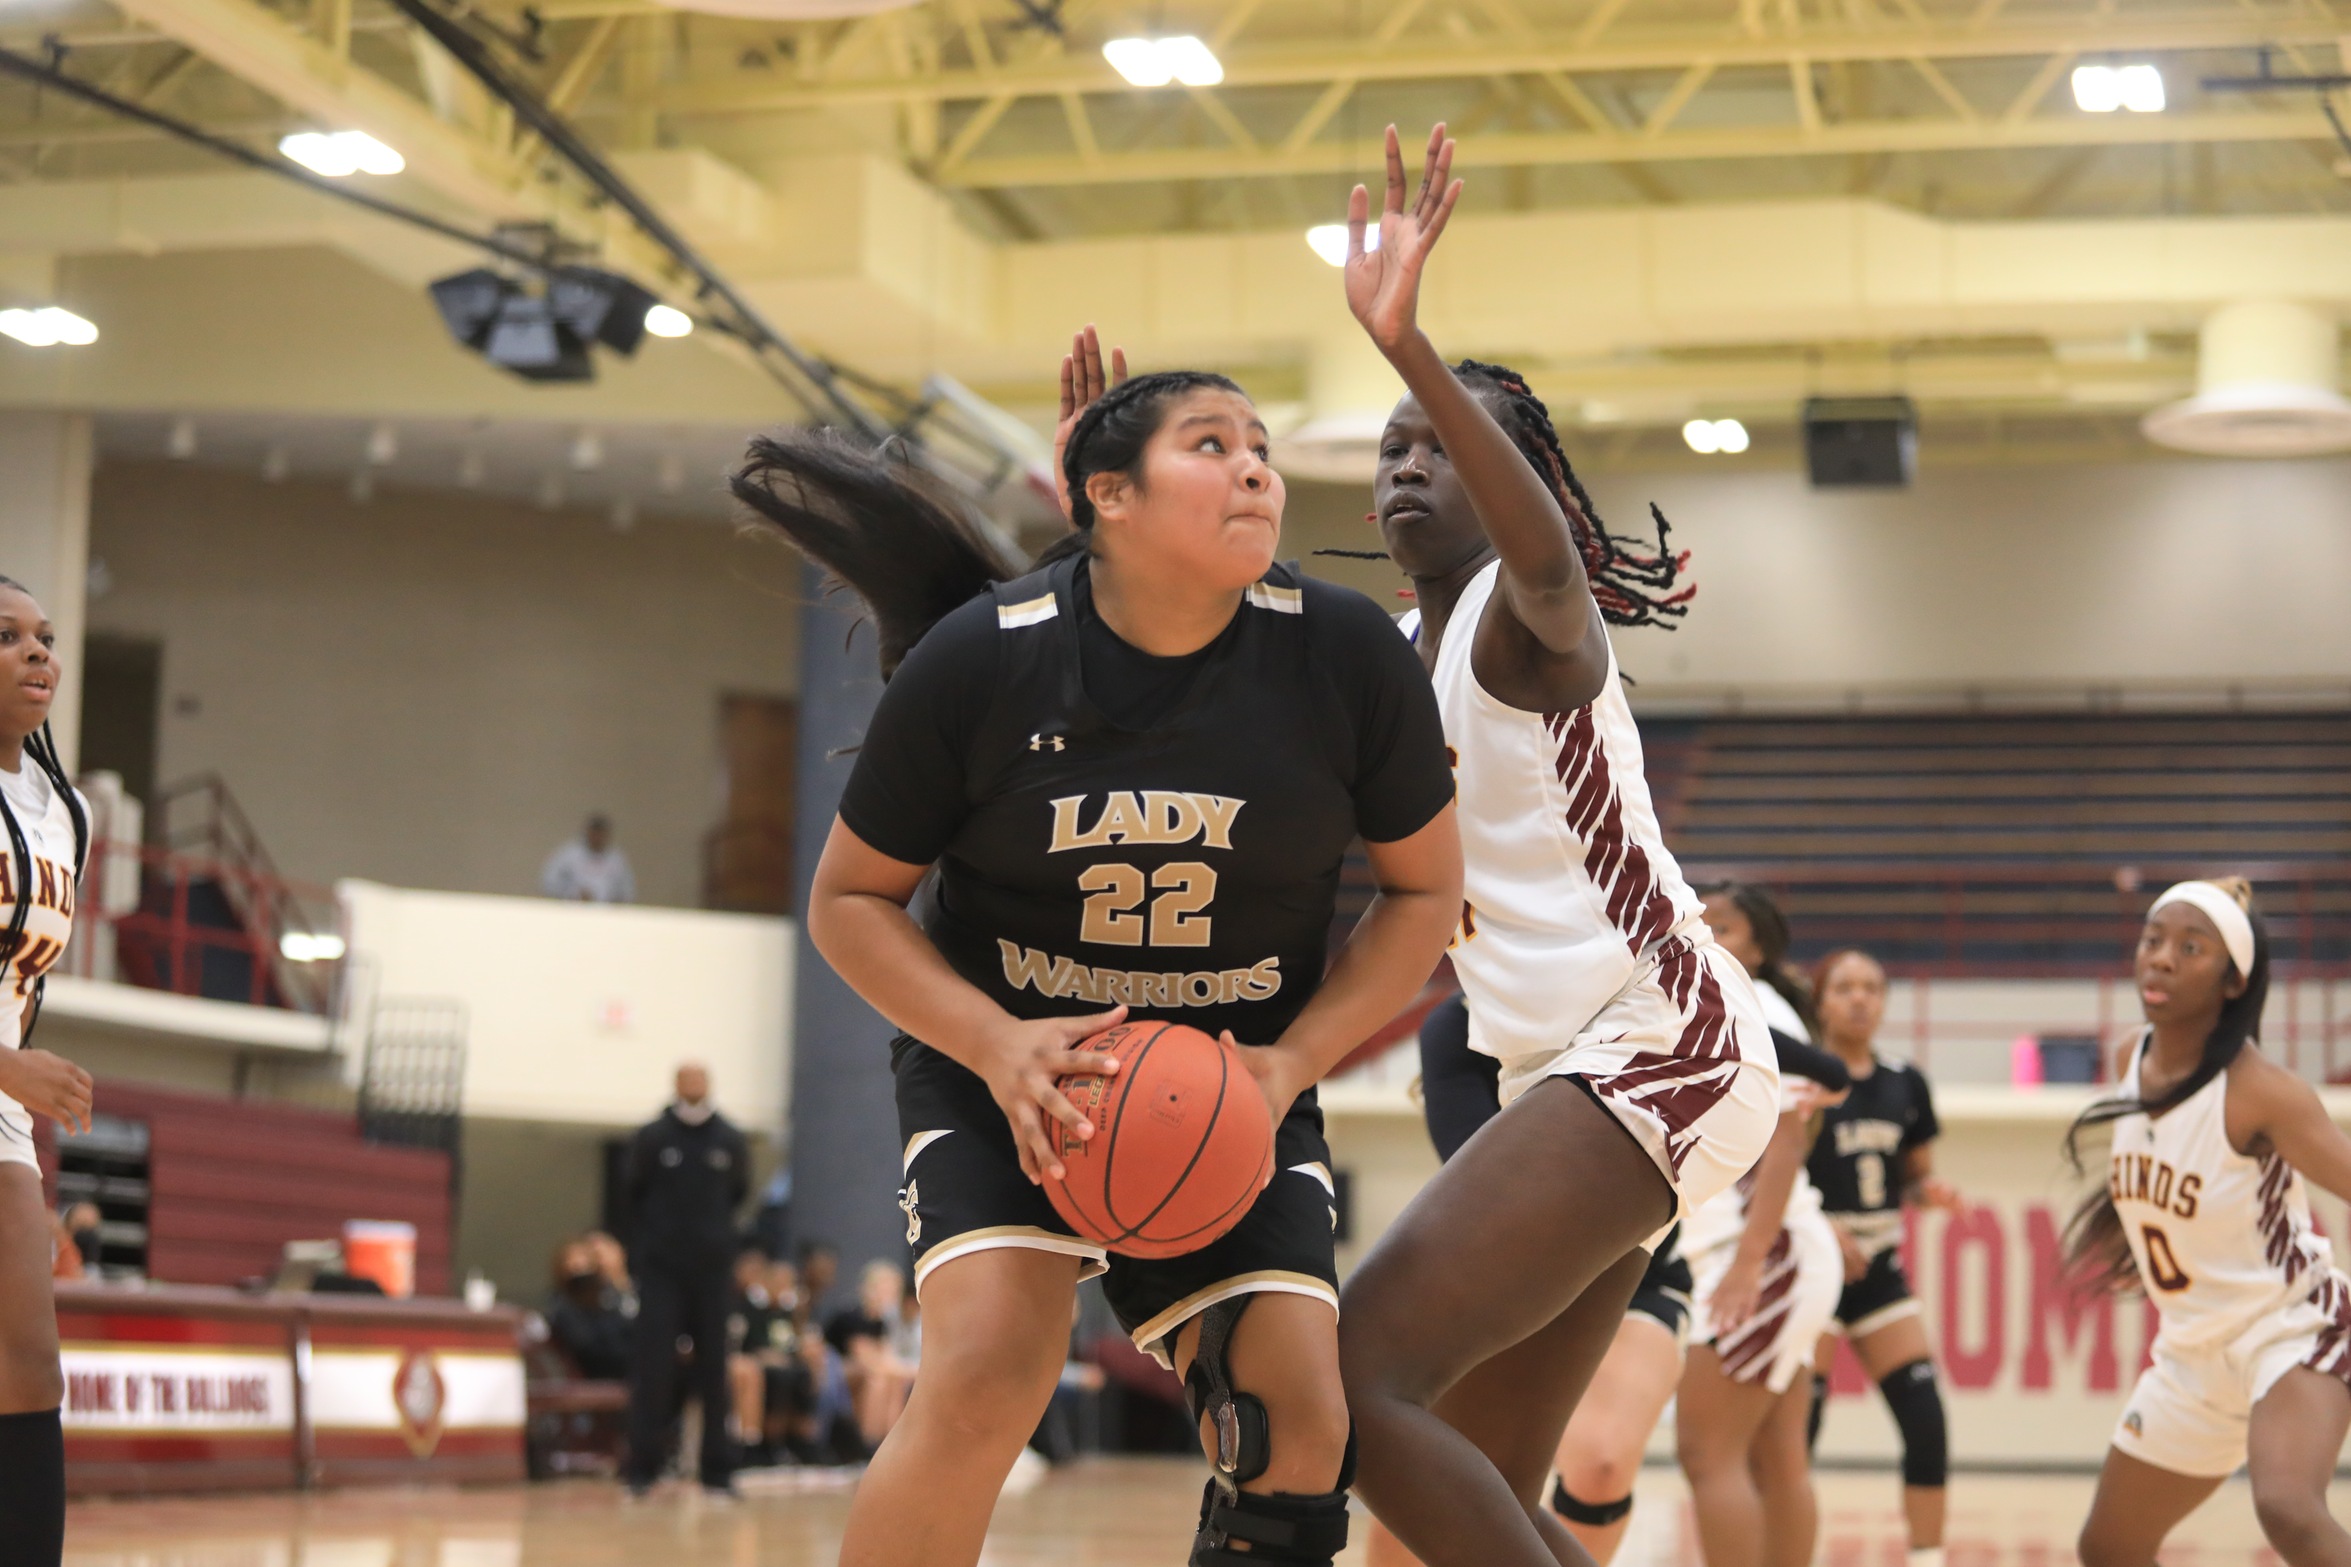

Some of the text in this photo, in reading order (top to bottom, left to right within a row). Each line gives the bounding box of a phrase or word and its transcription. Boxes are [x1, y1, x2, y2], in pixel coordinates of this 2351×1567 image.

[1046, 791, 1246, 853] LADY
[1077, 861, 1217, 947] 22
[997, 937, 1281, 1007] WARRIORS
[2140, 1219, 2193, 1293] 0
